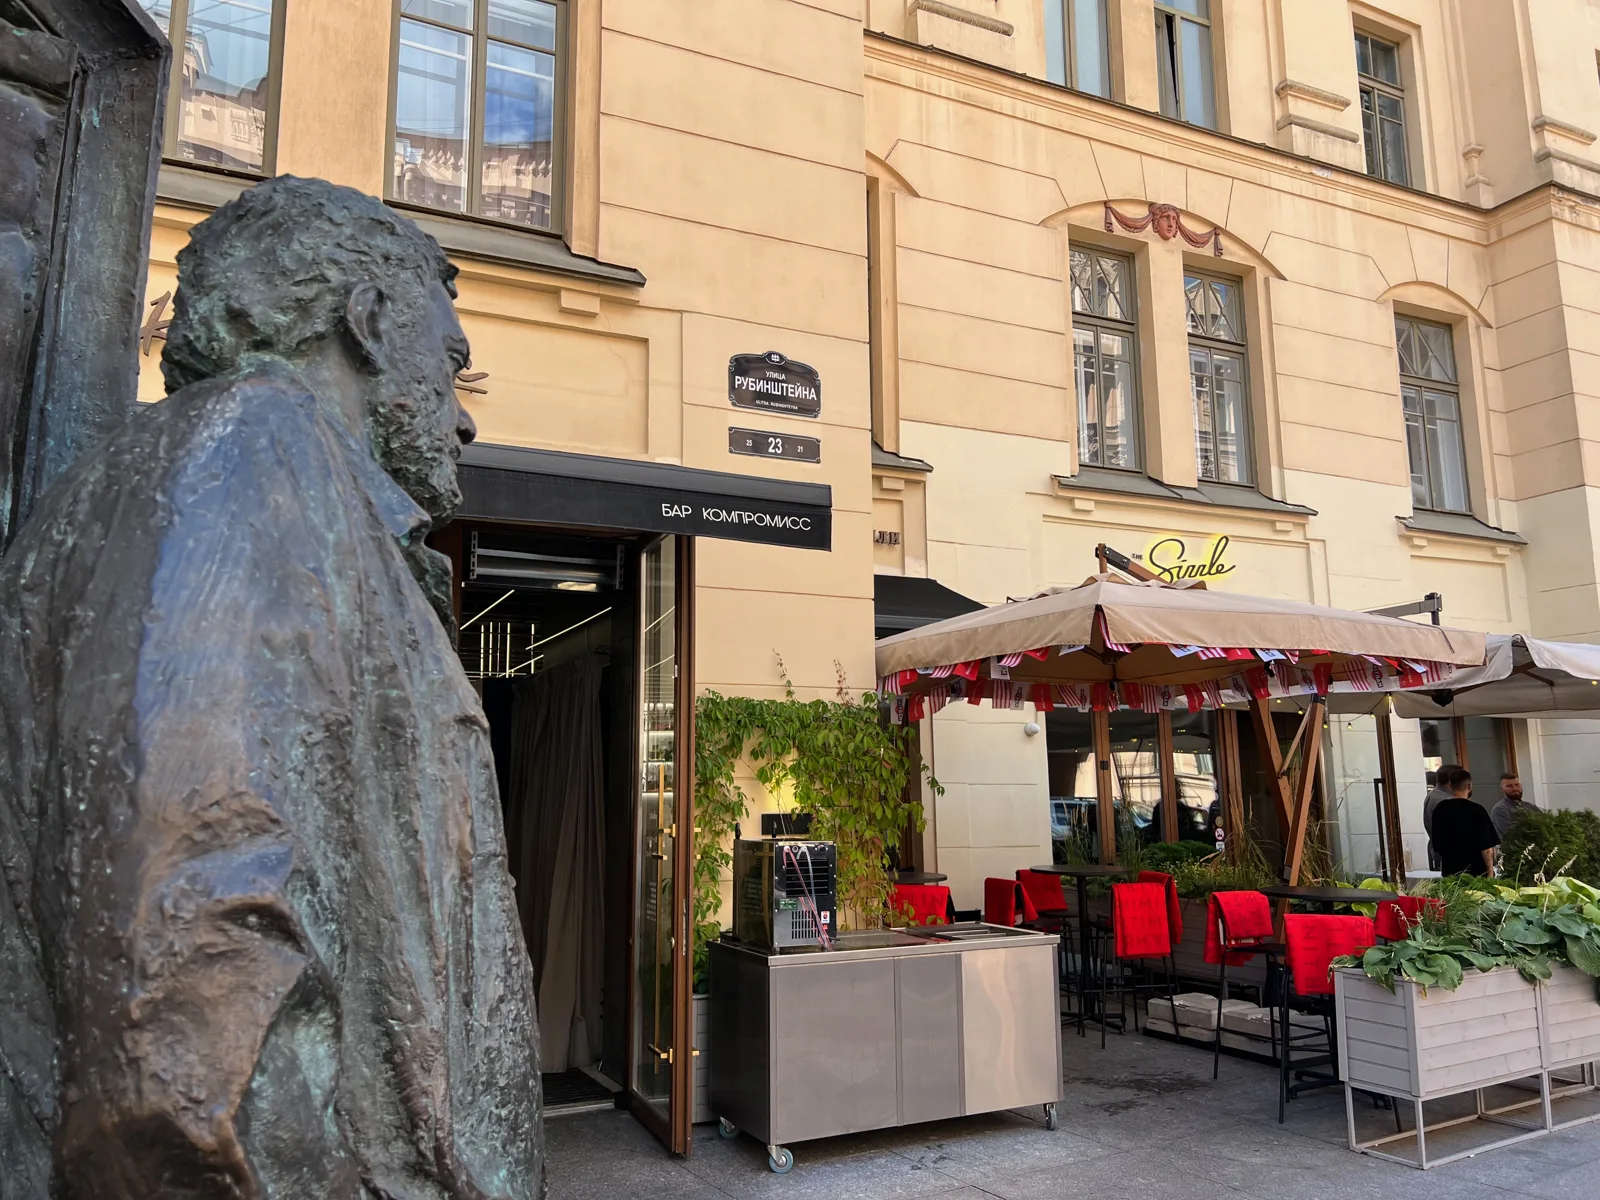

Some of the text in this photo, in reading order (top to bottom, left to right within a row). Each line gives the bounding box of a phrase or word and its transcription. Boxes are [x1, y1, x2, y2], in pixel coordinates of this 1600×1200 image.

[766, 371, 786, 380] УЛИЦА
[735, 376, 817, 401] РУБИНШТЕЙНА
[768, 437, 783, 454] 23
[661, 503, 812, 532] БАР КОМПРОМИСС
